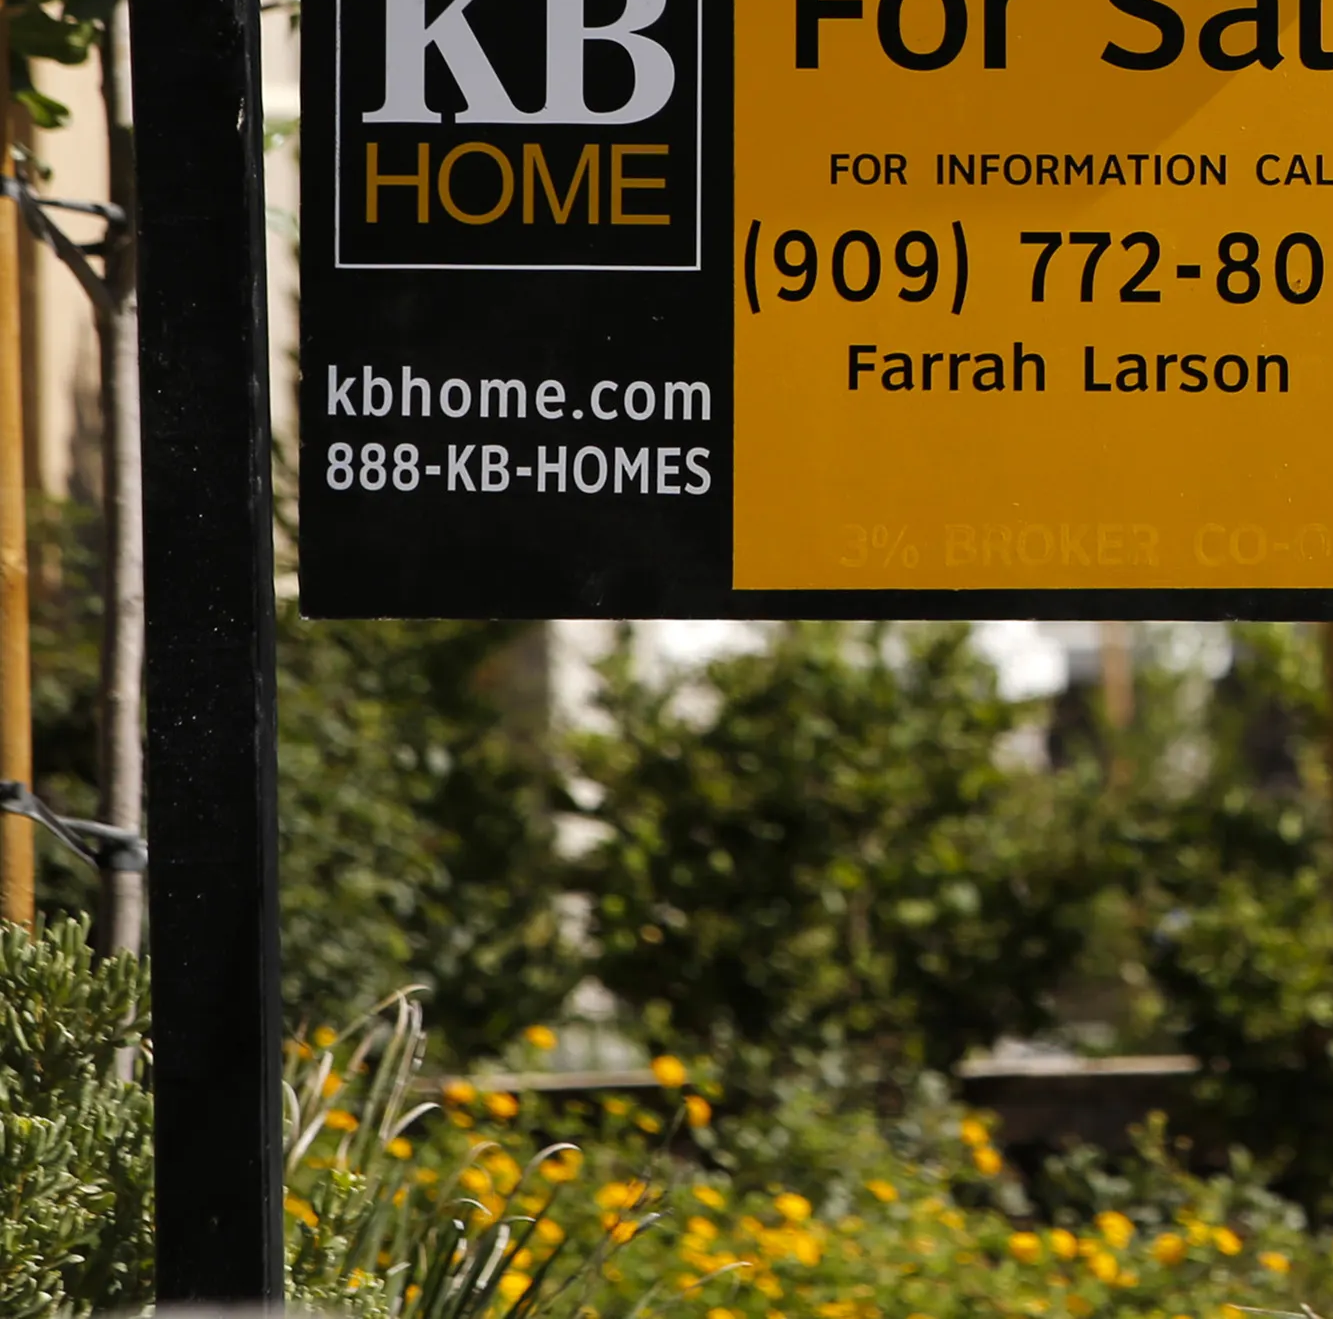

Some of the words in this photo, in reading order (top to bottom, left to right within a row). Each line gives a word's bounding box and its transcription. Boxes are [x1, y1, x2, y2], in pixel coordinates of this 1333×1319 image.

[366, 142, 670, 225] HOME
[830, 153, 908, 185] FOR
[936, 153, 1227, 186] INFORMATION
[744, 220, 969, 314] (909)
[327, 365, 711, 421] kbhome.com
[848, 342, 1045, 392] Farrah
[1084, 345, 1289, 393] Larson
[326, 442, 711, 495] 888-KB-HOMES
[839, 523, 919, 569] 3%
[944, 522, 1160, 568] BROKER
